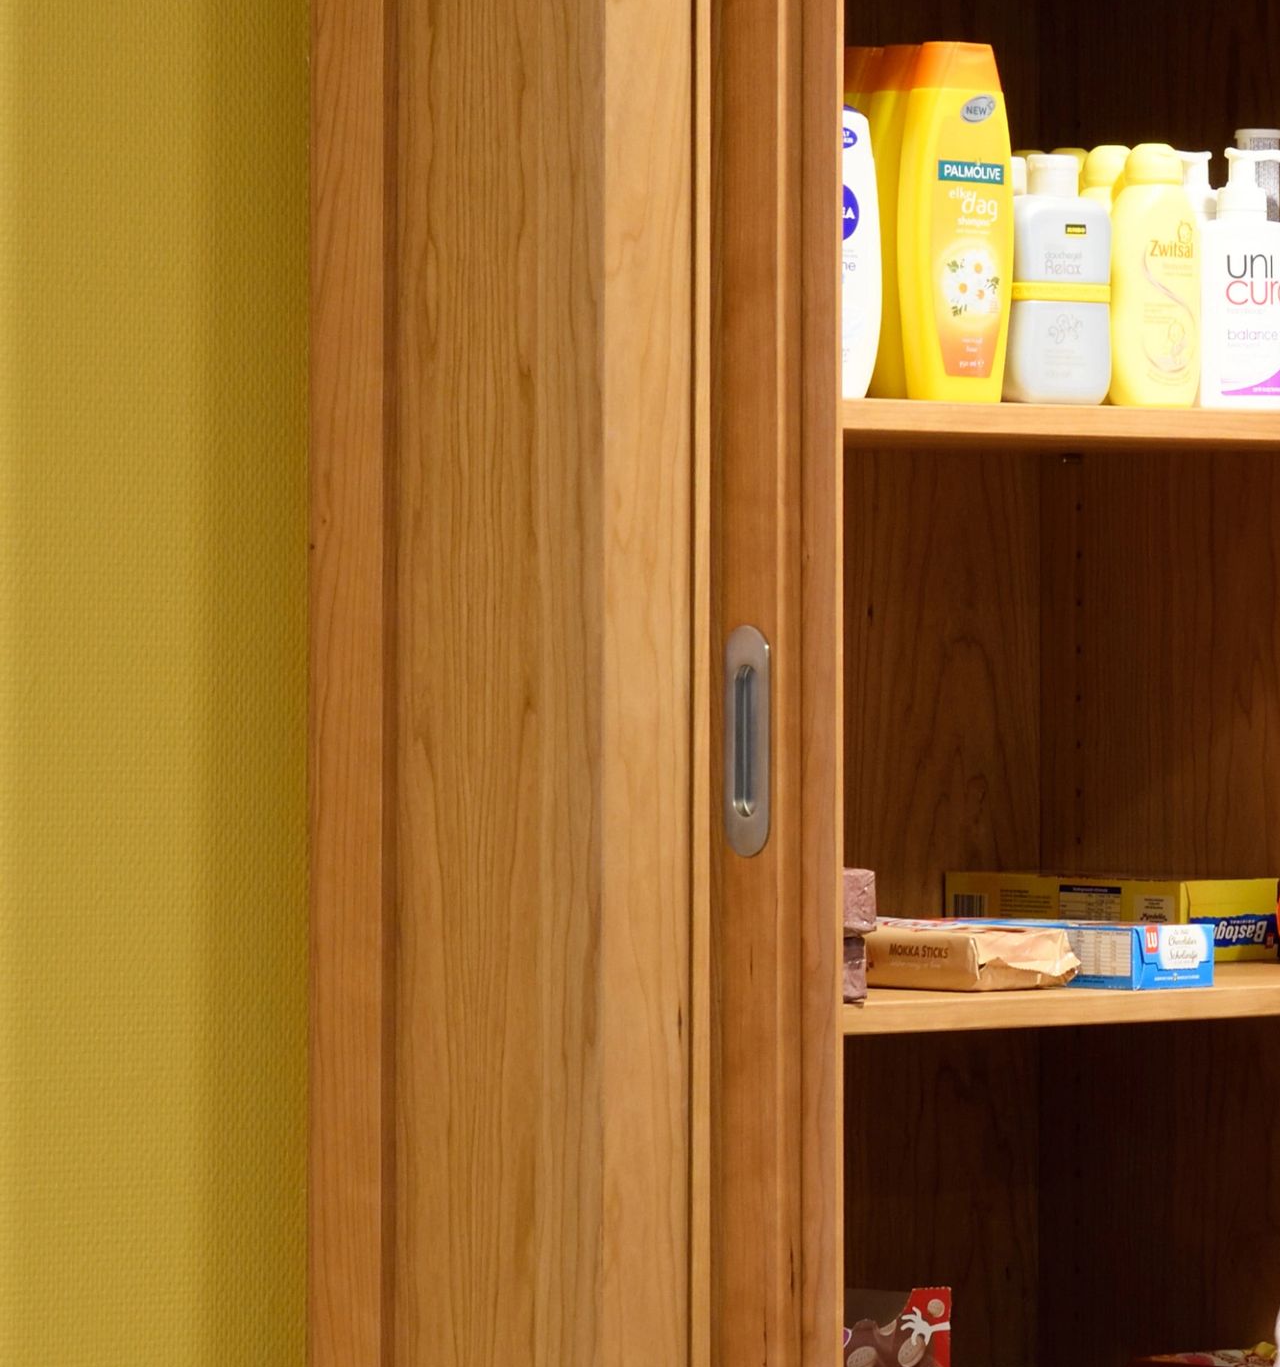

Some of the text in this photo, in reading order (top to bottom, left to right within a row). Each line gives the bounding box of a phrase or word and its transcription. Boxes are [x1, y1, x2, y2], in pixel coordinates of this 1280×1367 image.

[965, 106, 988, 115] NEW
[943, 164, 1002, 181] PALMOLIVE
[960, 191, 998, 223] dag
[1150, 240, 1194, 259] Zwitsal
[1045, 260, 1081, 275] Relax
[1227, 254, 1273, 279] uni
[1227, 329, 1279, 341] balance
[1146, 931, 1158, 949] LU
[888, 943, 949, 960] MOKKA STICKS
